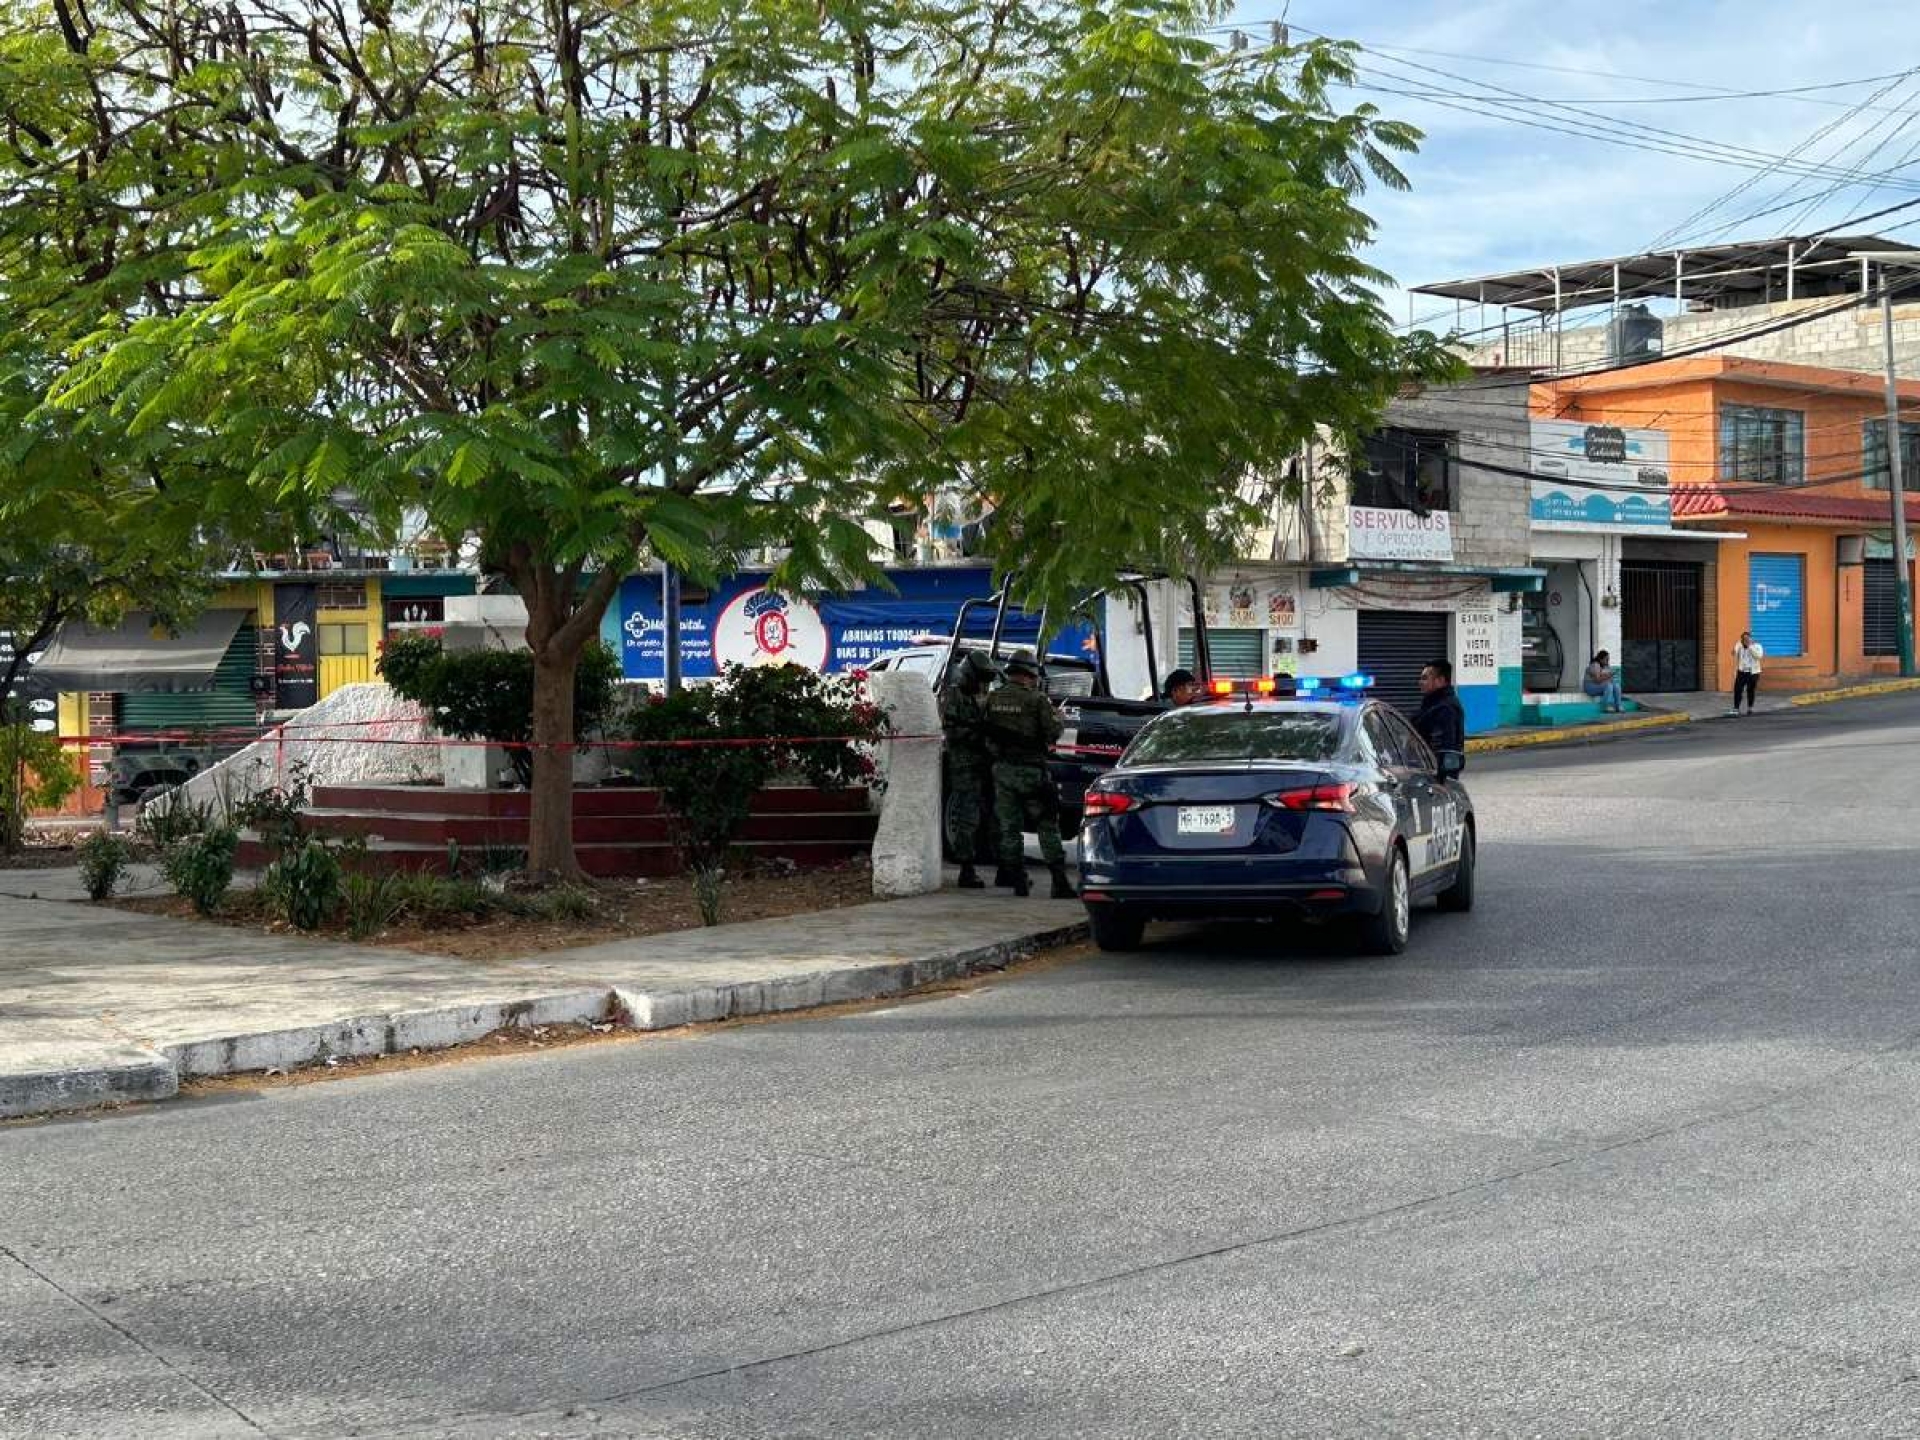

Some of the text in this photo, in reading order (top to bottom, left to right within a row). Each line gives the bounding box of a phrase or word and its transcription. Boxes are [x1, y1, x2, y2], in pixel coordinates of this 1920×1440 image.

[1353, 510, 1445, 531] SERVICIOS
[842, 629, 884, 643] ABRIMOS
[859, 647, 870, 659] DE
[1463, 653, 1494, 668] GRATIS
